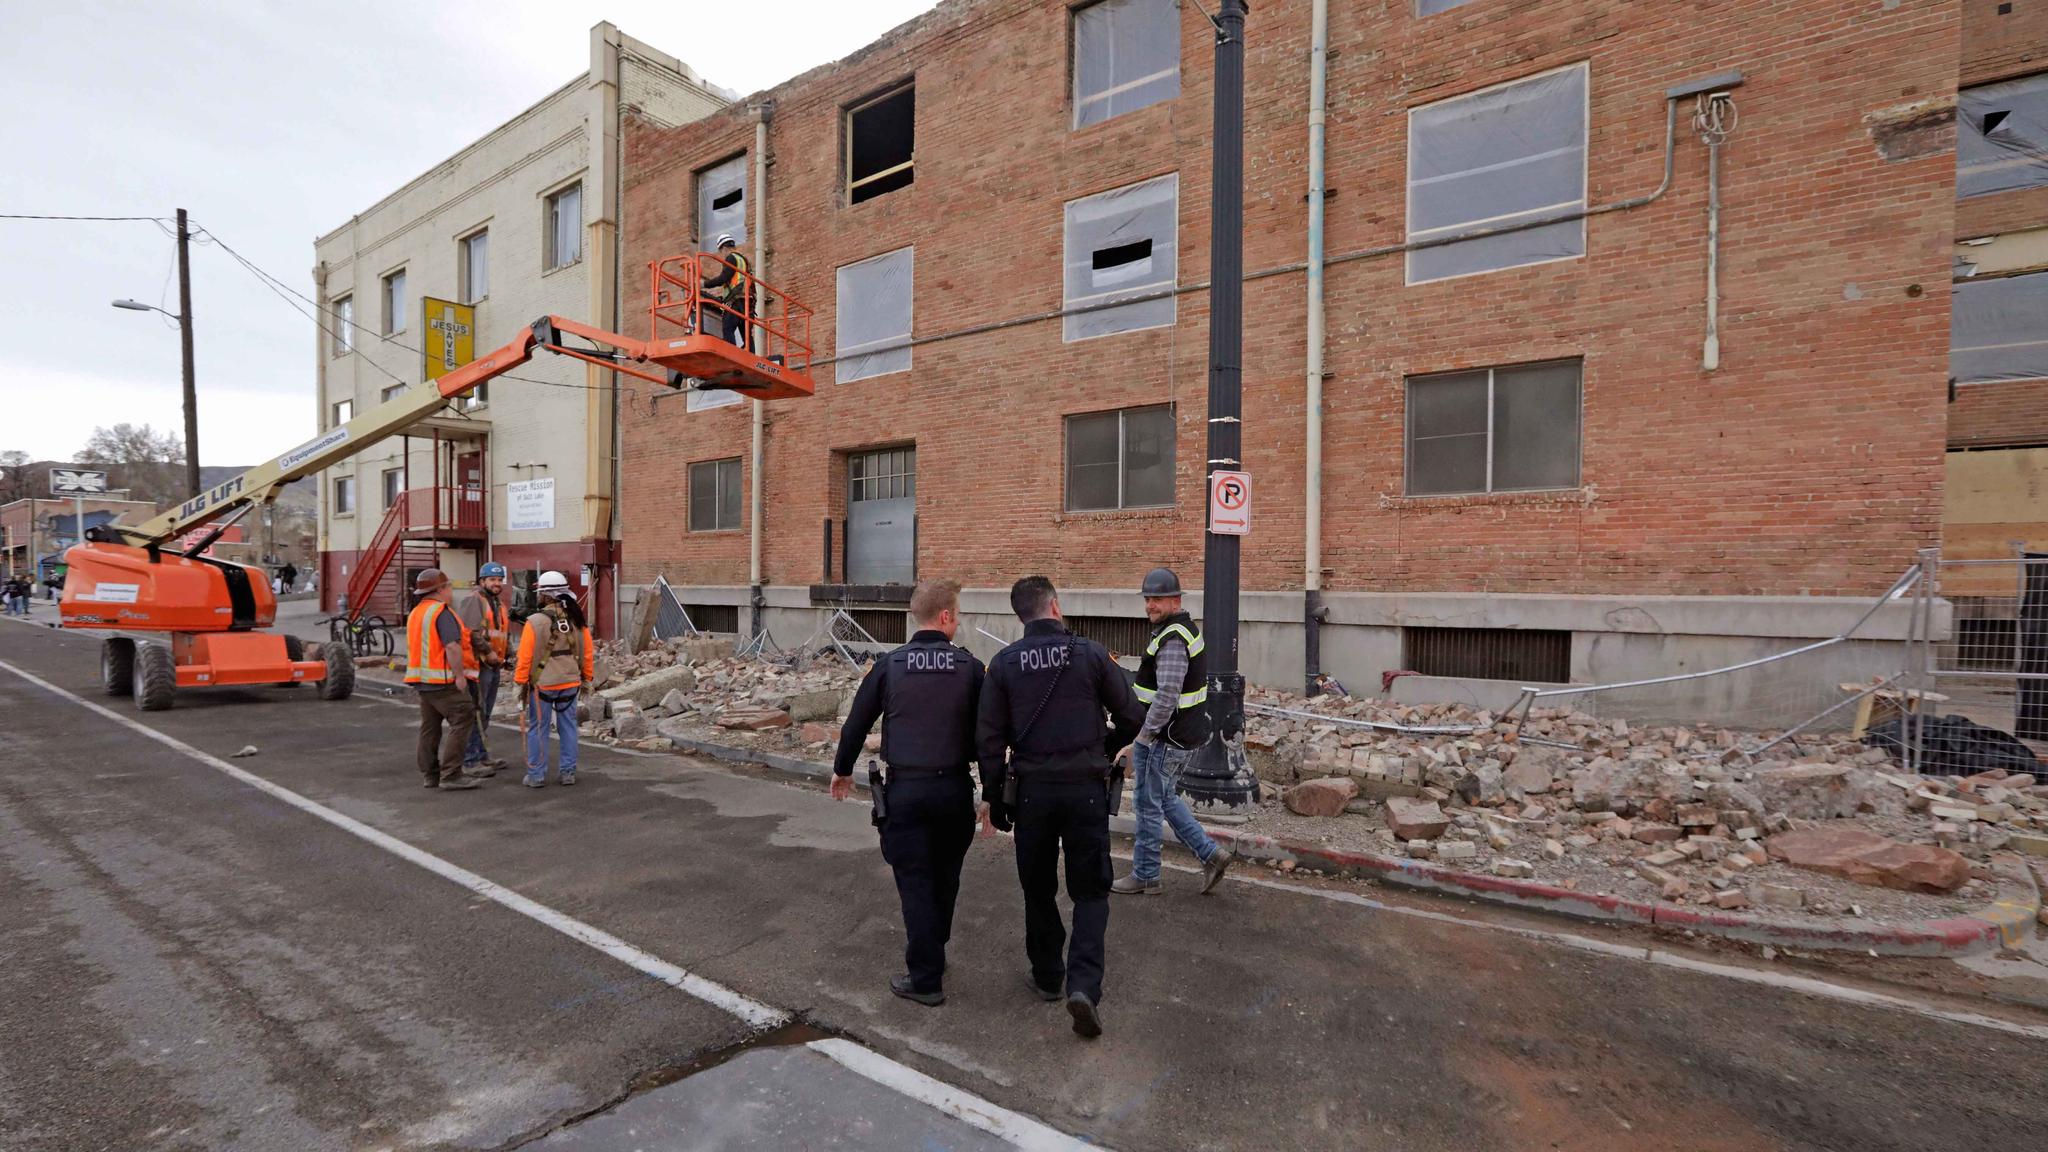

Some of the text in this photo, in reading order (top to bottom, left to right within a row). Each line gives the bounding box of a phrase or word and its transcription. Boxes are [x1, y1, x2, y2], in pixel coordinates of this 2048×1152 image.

[433, 321, 466, 334] JESUS
[290, 432, 345, 463] EquipmentShare
[509, 480, 553, 493] Rescue Mission
[1225, 484, 1240, 503] P
[180, 476, 243, 520] JLG LIFT
[907, 652, 954, 670] POLICE
[1021, 646, 1069, 671] POLICE
